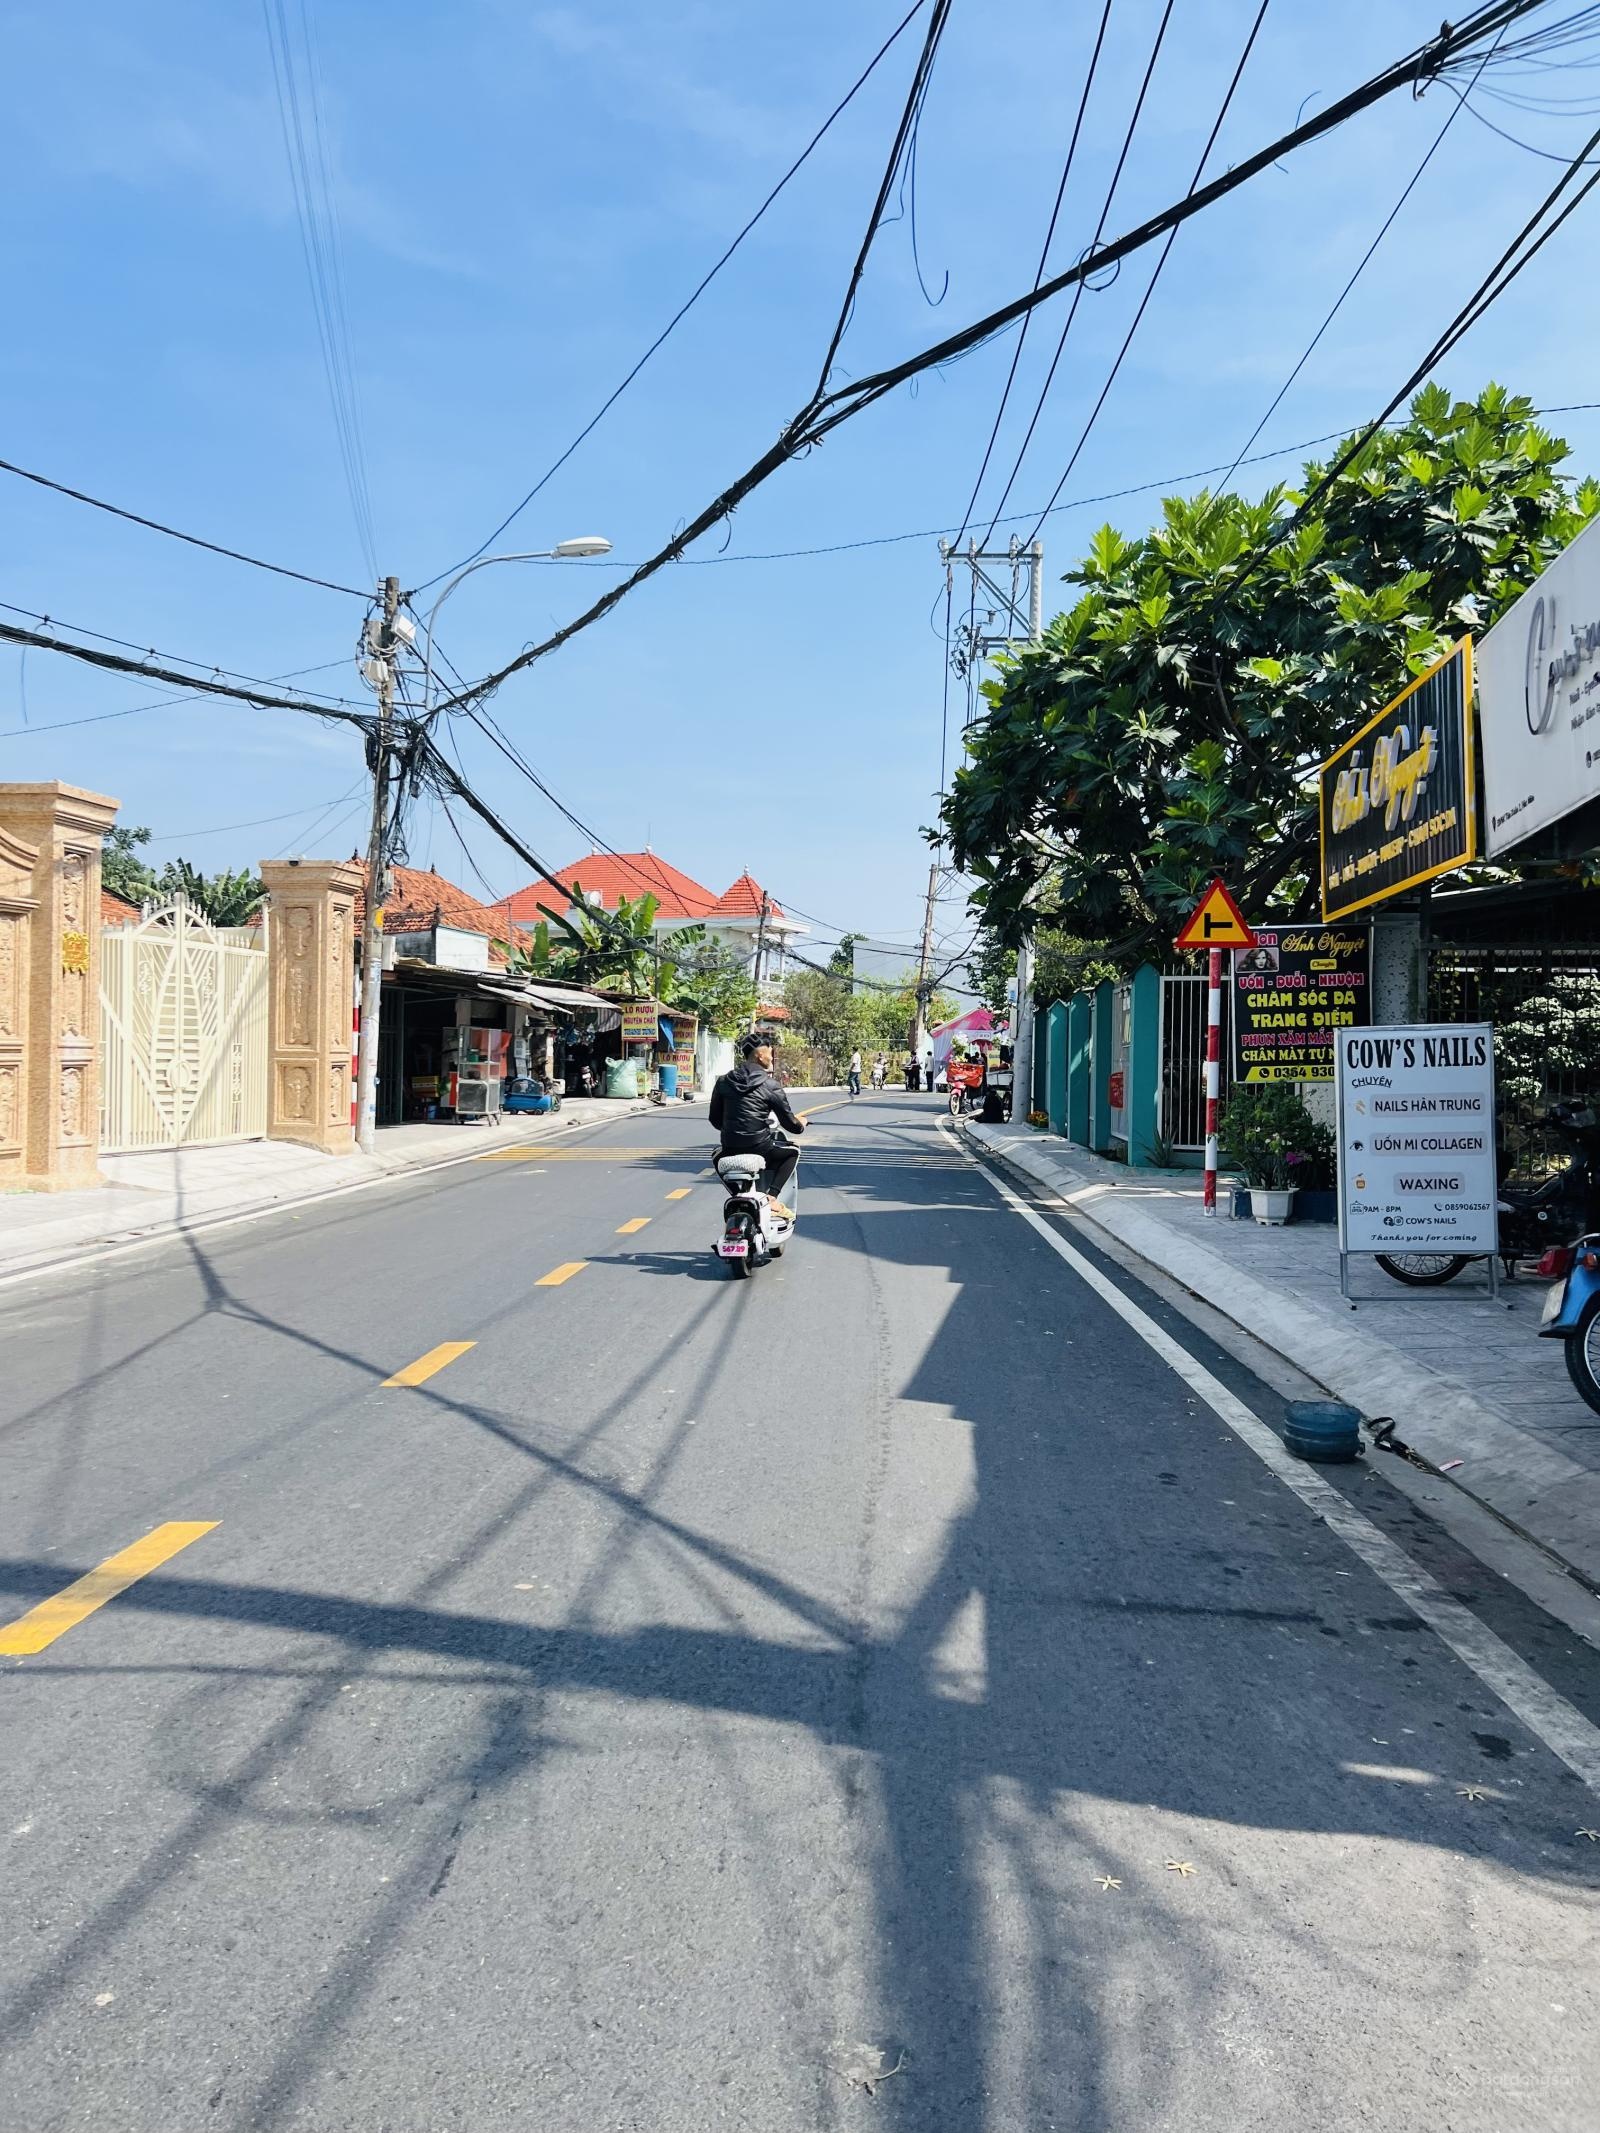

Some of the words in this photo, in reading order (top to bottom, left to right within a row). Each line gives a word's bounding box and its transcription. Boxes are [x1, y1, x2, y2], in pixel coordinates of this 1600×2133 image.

[1253, 931, 1278, 947] lon
[1281, 930, 1315, 952] Ánh
[1317, 931, 1365, 958] Nguyệt
[1238, 972, 1265, 990] UỐN
[1318, 970, 1365, 988] NHUỘM
[1246, 990, 1293, 1008] CHĂM
[1298, 989, 1328, 1007] SÓC
[1333, 990, 1356, 1005] DA
[1250, 1011, 1307, 1028] TRANG
[1312, 1007, 1354, 1026] ĐIỂM
[1240, 1033, 1276, 1047] PHUN
[1277, 1030, 1306, 1046] XĂM
[1241, 1047, 1276, 1062] CHÂN
[1278, 1046, 1307, 1061] MÀY
[1308, 1046, 1327, 1062] TỰ
[1347, 1038, 1416, 1069] COW'S
[1423, 1036, 1486, 1068] NAILS
[1375, 1100, 1408, 1112] NAILS
[1411, 1097, 1437, 1111] HÀN
[1439, 1098, 1481, 1111] TRUNG
[1374, 1134, 1400, 1151] UỐN
[1404, 1138, 1418, 1150] MI
[1420, 1137, 1483, 1150] COLLAGEN
[1399, 1178, 1459, 1190] WAXING
[1363, 1205, 1380, 1213] 9AM
[1385, 1205, 1402, 1213] 8PM
[1405, 1217, 1433, 1225] COW'S
[1434, 1217, 1457, 1225] NAILS
[1425, 1233, 1442, 1242] for
[1443, 1233, 1478, 1242] coming
